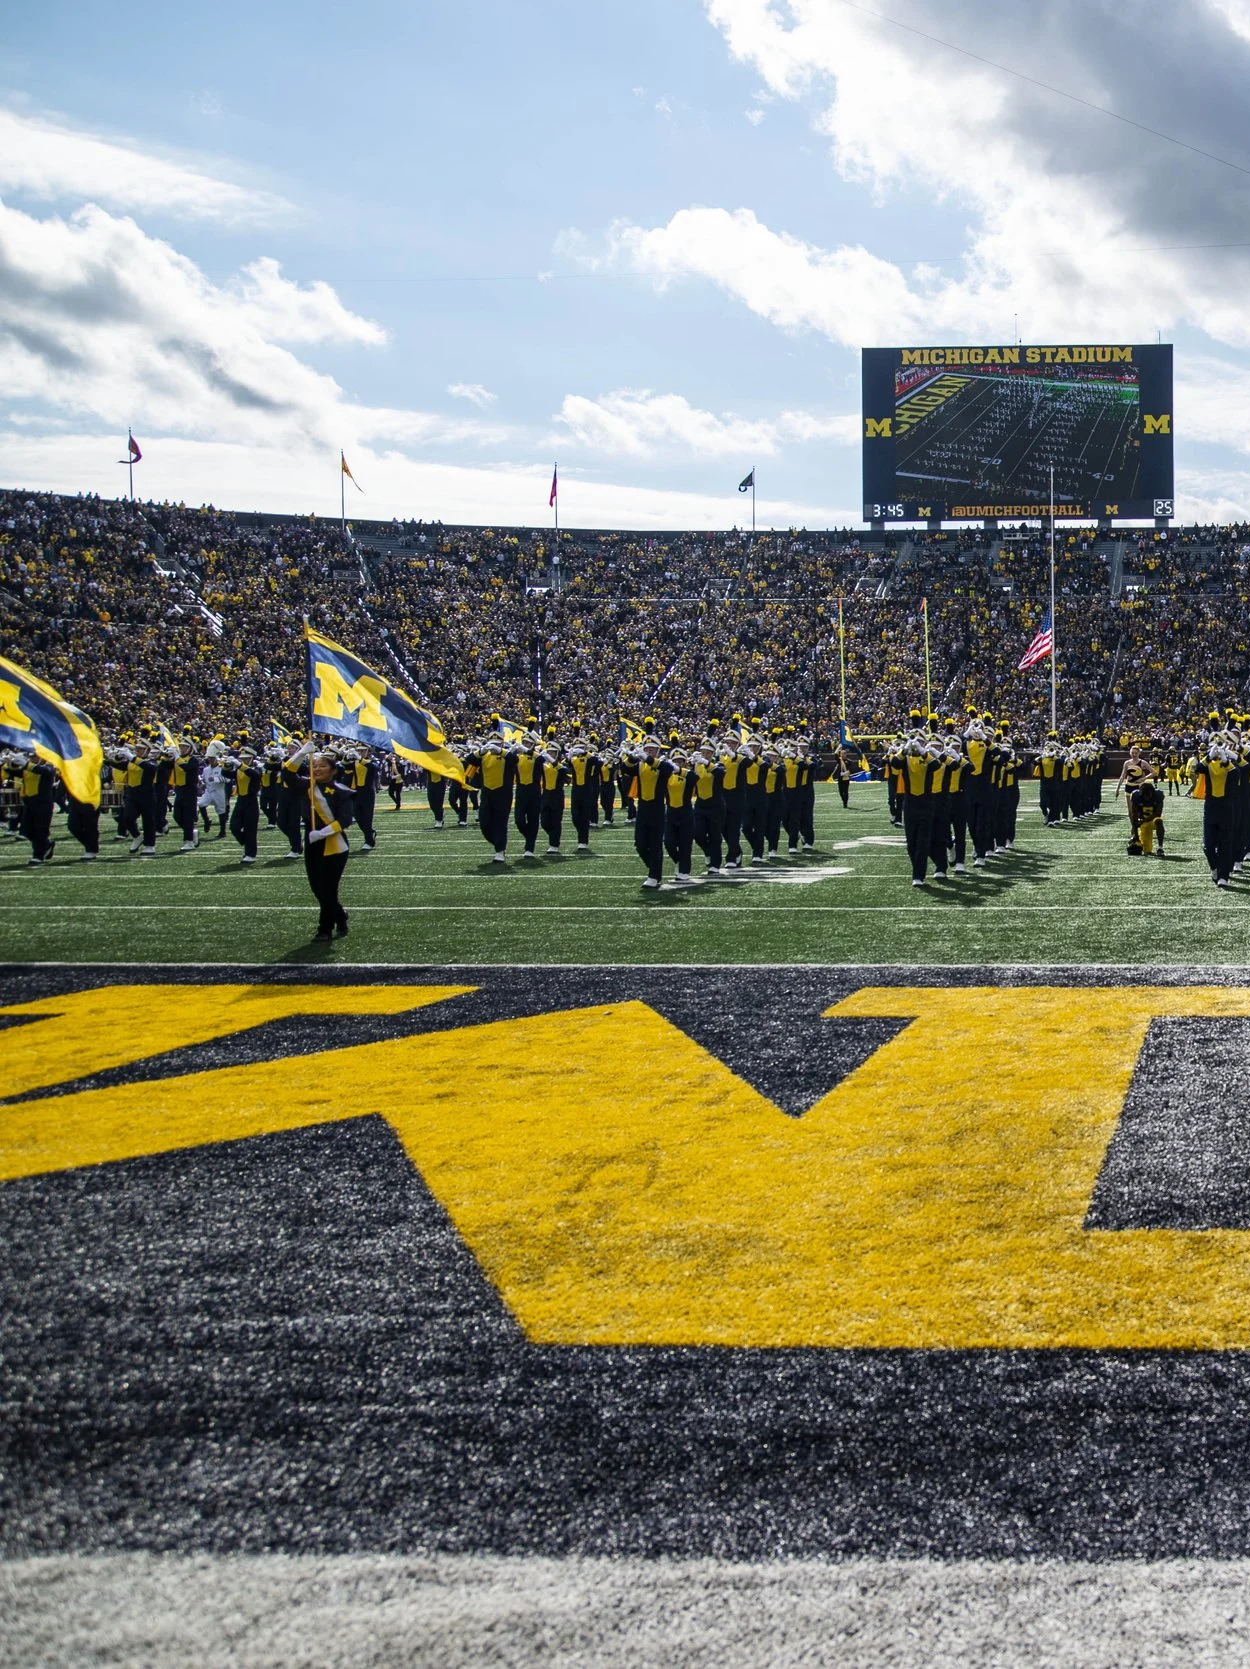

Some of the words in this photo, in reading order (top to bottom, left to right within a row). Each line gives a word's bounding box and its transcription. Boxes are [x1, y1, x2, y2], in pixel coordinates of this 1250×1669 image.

[901, 348, 1020, 365] MICHIGAN
[1026, 347, 1133, 363] STADIUM
[866, 418, 892, 437] M
[1144, 415, 1170, 434] M
[873, 504, 904, 517] 3:45
[918, 507, 931, 517] M
[952, 504, 1084, 517] @UMICHFOOTBALL
[1106, 505, 1119, 515] M
[1156, 501, 1172, 514] 25
[302, 661, 389, 732] M
